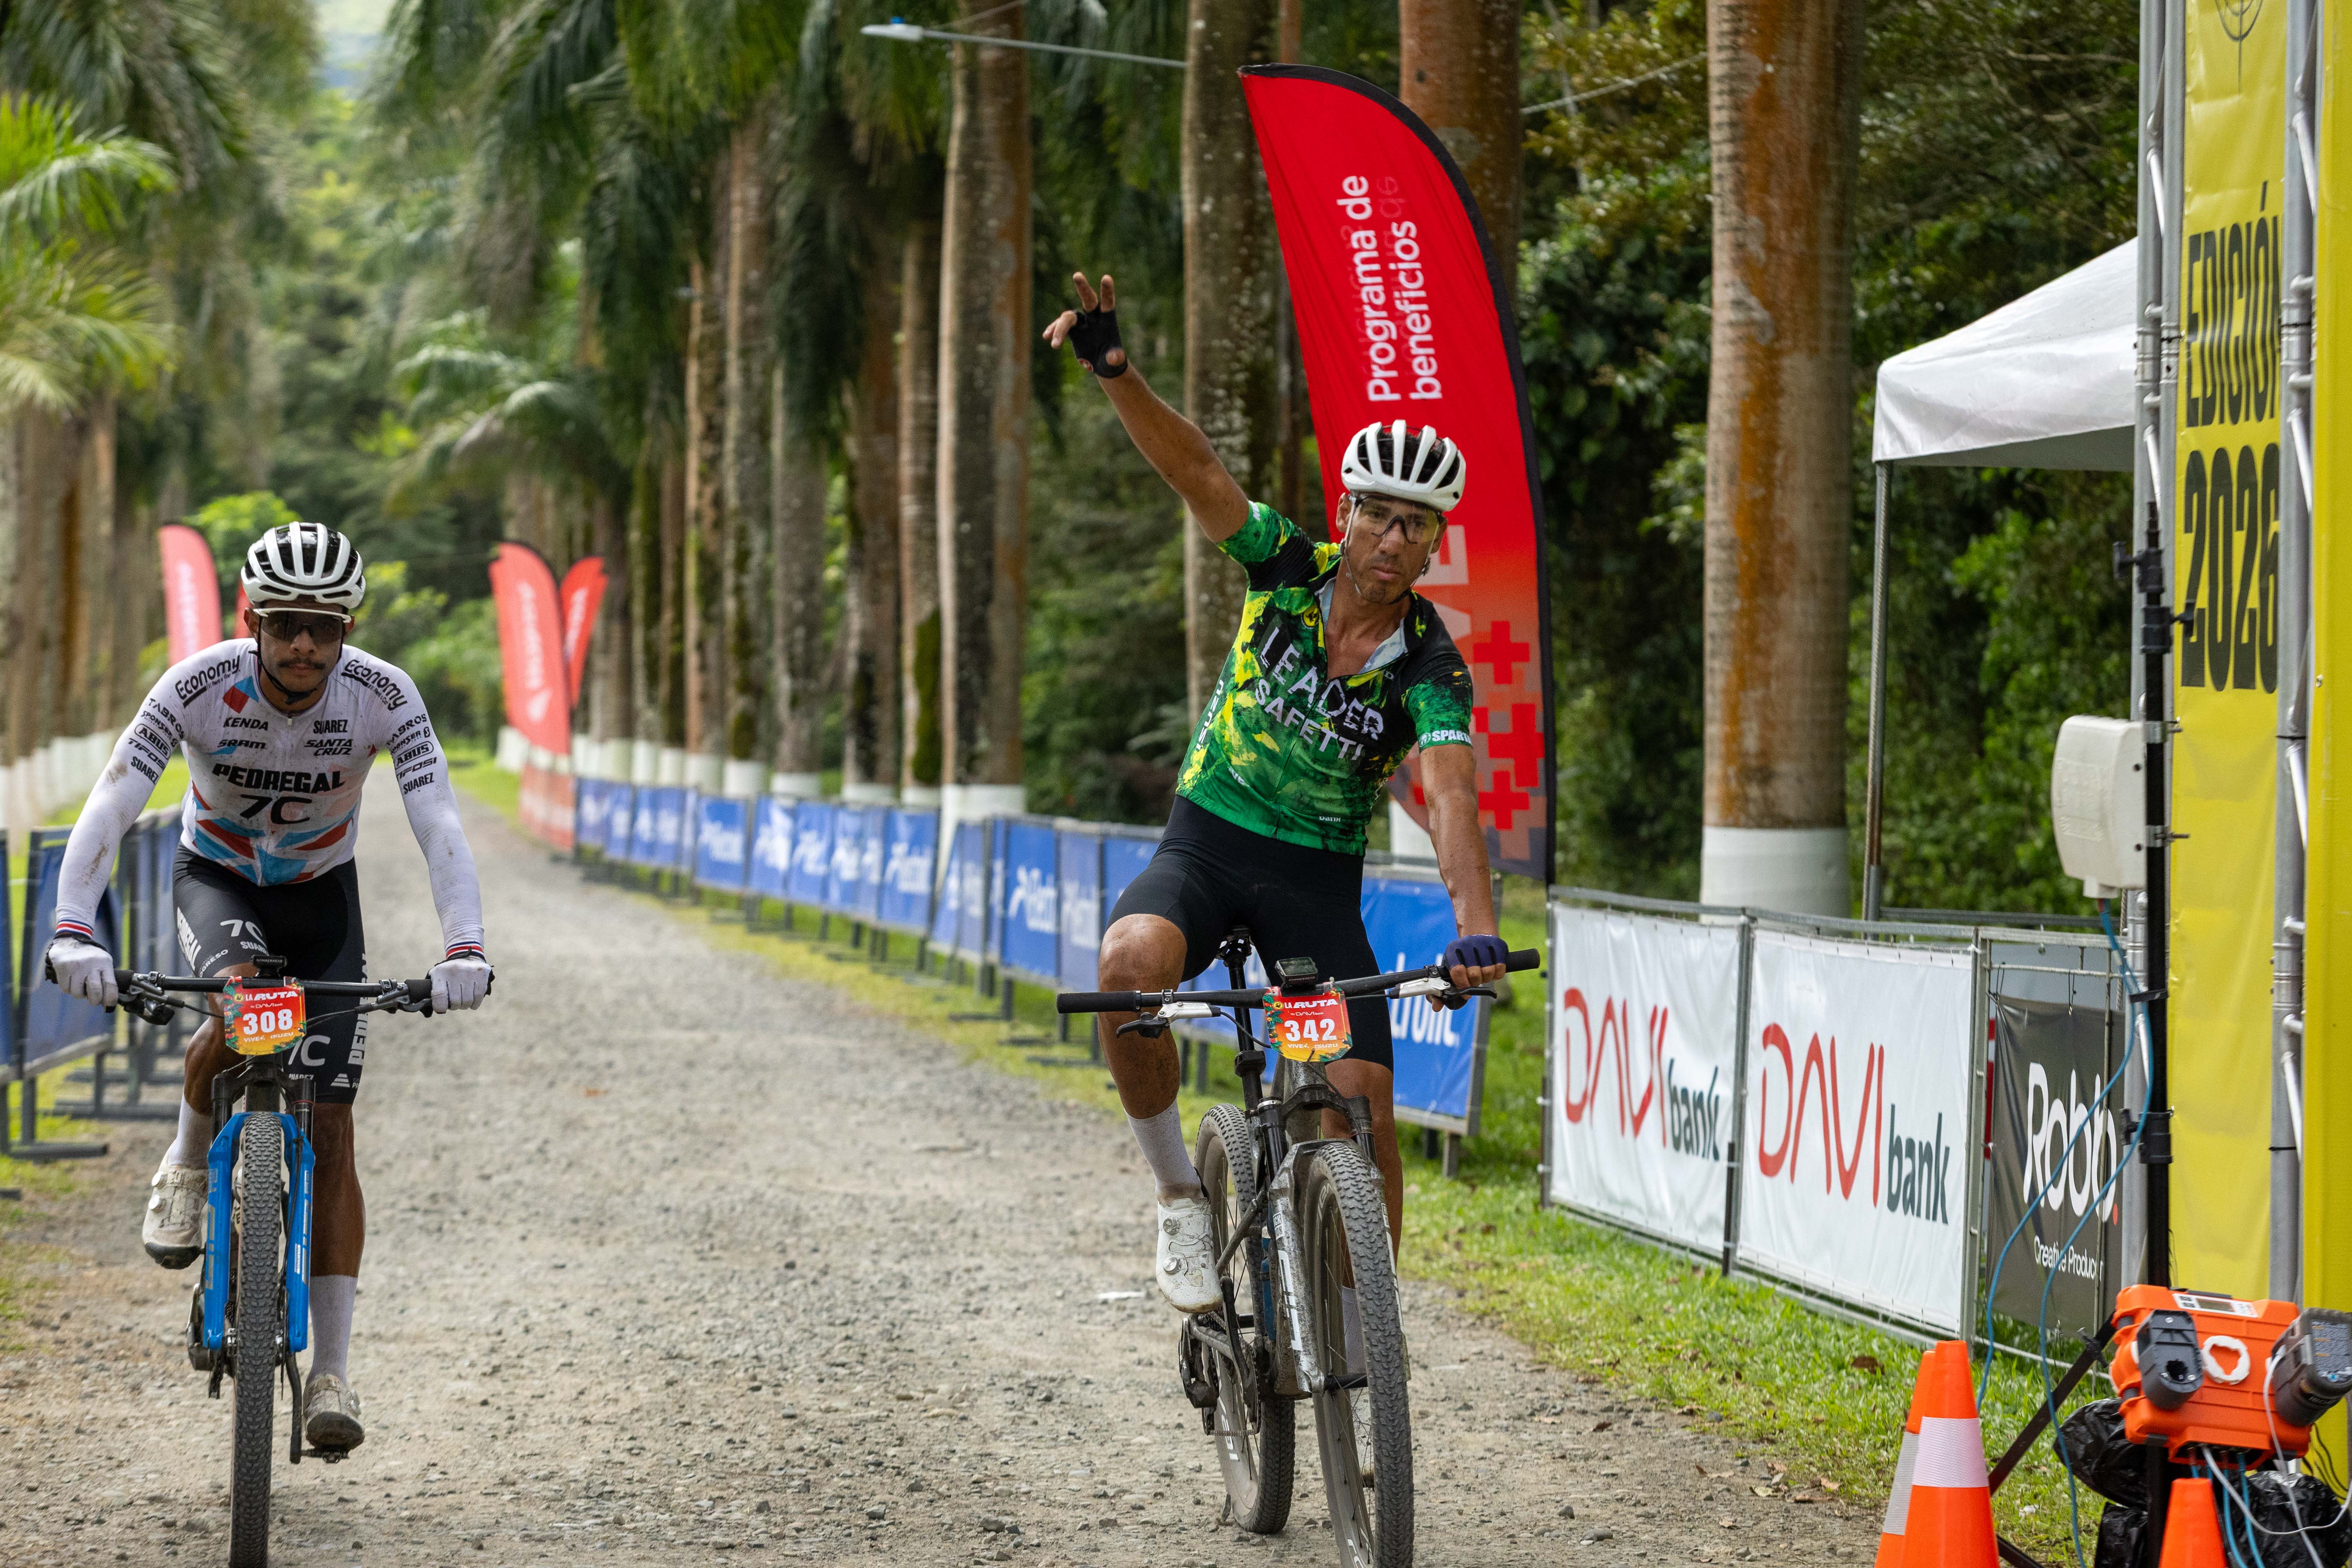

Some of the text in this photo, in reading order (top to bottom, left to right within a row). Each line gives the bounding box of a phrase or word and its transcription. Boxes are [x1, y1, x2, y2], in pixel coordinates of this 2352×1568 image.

[1337, 175, 1401, 401] Programa de
[1390, 221, 1442, 400] beneficios
[2181, 443, 2279, 694] 2026
[175, 655, 240, 700] Economy
[345, 659, 408, 711] Economy
[1260, 627, 1384, 740] LEADER
[223, 717, 269, 731] KENDA
[313, 719, 348, 734] SUAREZ
[1196, 679, 1224, 750] ISUZU
[1255, 679, 1364, 760] SAFETTI
[138, 727, 169, 757] ABUS
[217, 739, 267, 750] SRAM
[303, 739, 353, 748] SANTA
[313, 747, 352, 757] CRUZ
[396, 744, 430, 767] ABUS
[212, 763, 347, 794] PEDREGAL
[403, 772, 435, 795] SUAREZ
[239, 794, 313, 825] 7C
[199, 949, 229, 978] OGRESO
[253, 991, 298, 1001] RUTA
[1293, 998, 1339, 1009] RUTA
[243, 1009, 293, 1035] 308
[1284, 1018, 1337, 1042] 342
[1668, 1057, 1720, 1162] bank
[1886, 1103, 1950, 1226] bank
[2068, 1245, 2104, 1282] Producr
